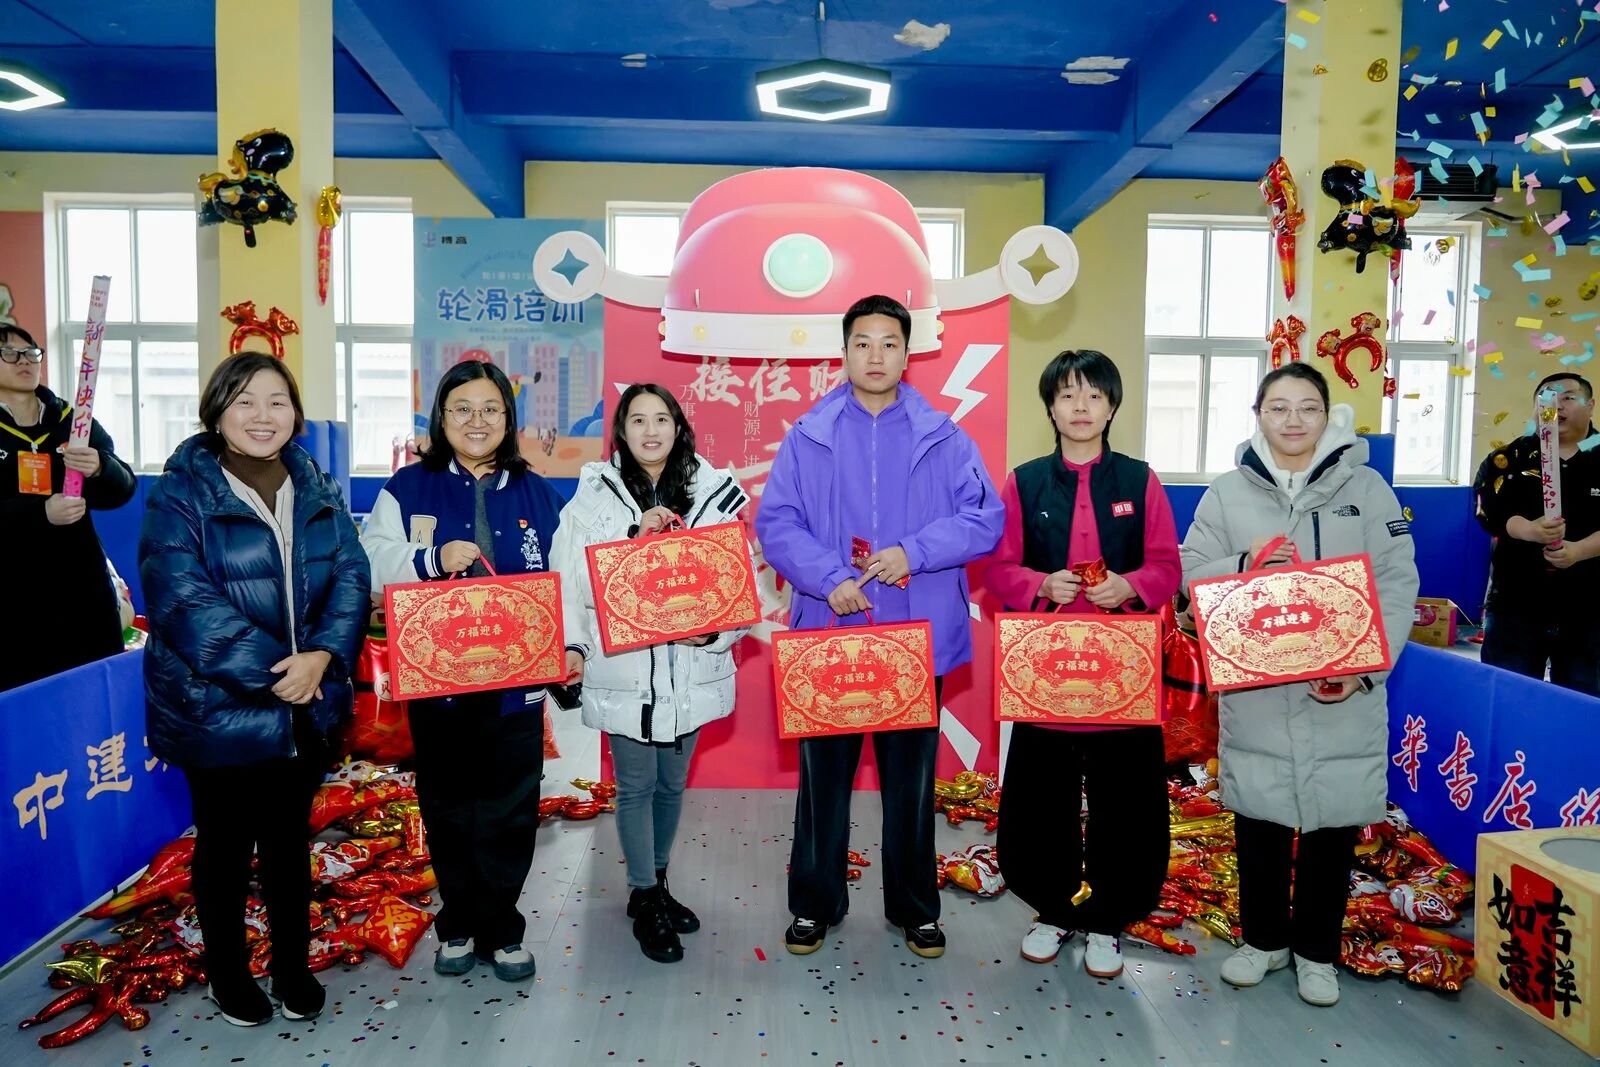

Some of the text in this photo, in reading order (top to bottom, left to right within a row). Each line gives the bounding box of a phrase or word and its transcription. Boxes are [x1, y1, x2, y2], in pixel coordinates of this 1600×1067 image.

[656, 572, 699, 590] 万福迎春
[1260, 611, 1313, 629] 万福迎春
[455, 623, 503, 639] 万福迎春
[1054, 659, 1101, 672] 万福迎春
[832, 670, 877, 685] 万福迎春
[12, 730, 168, 841] 中建
